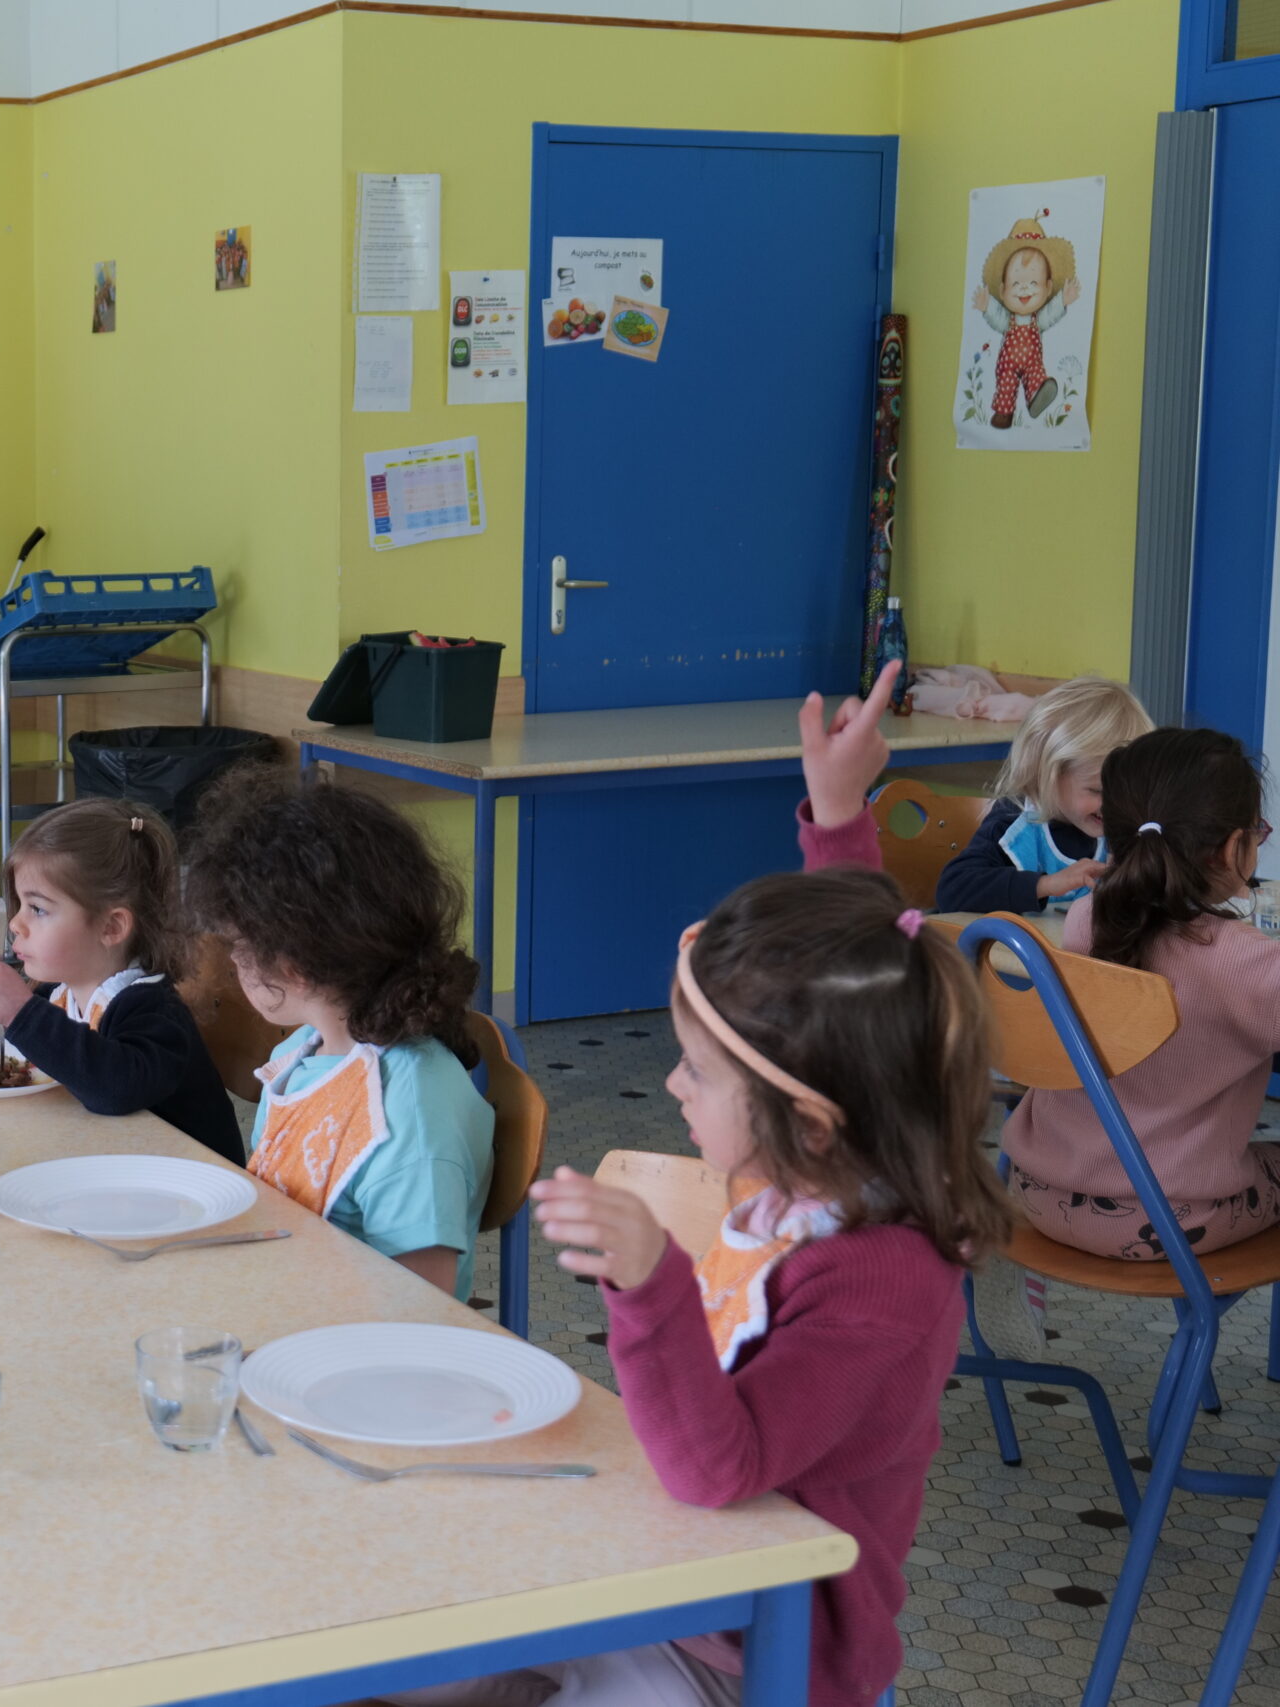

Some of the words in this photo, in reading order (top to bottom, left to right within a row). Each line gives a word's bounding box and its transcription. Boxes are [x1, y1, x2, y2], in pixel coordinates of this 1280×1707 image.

[613, 249, 620, 260] je
[621, 249, 638, 258] mets
[594, 262, 622, 271] compost
